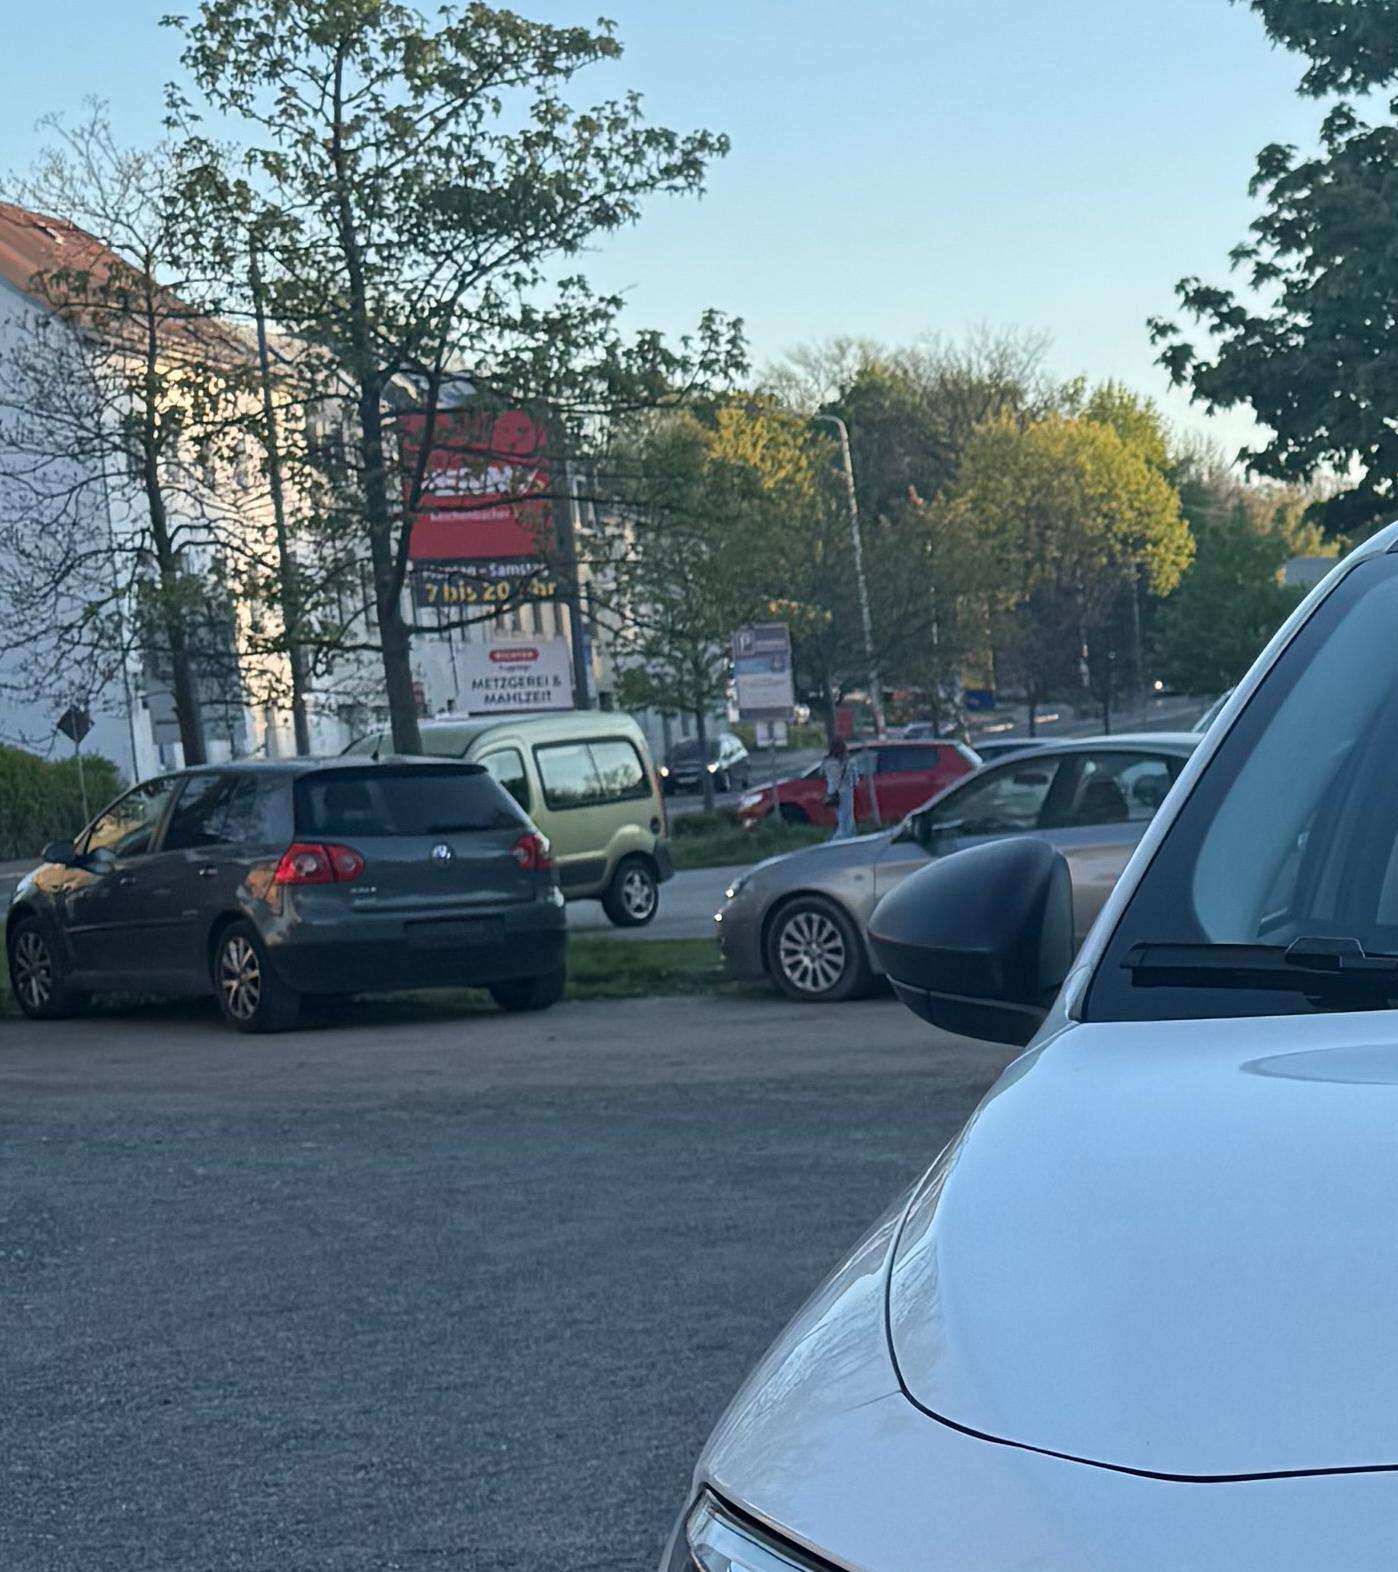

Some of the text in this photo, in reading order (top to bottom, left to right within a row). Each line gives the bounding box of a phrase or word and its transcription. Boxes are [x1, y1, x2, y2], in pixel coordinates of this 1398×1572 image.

[444, 580, 477, 602] bis
[482, 582, 510, 601] 20
[472, 675, 548, 689] METZGEREI
[484, 691, 551, 705] MAHLZEIT
